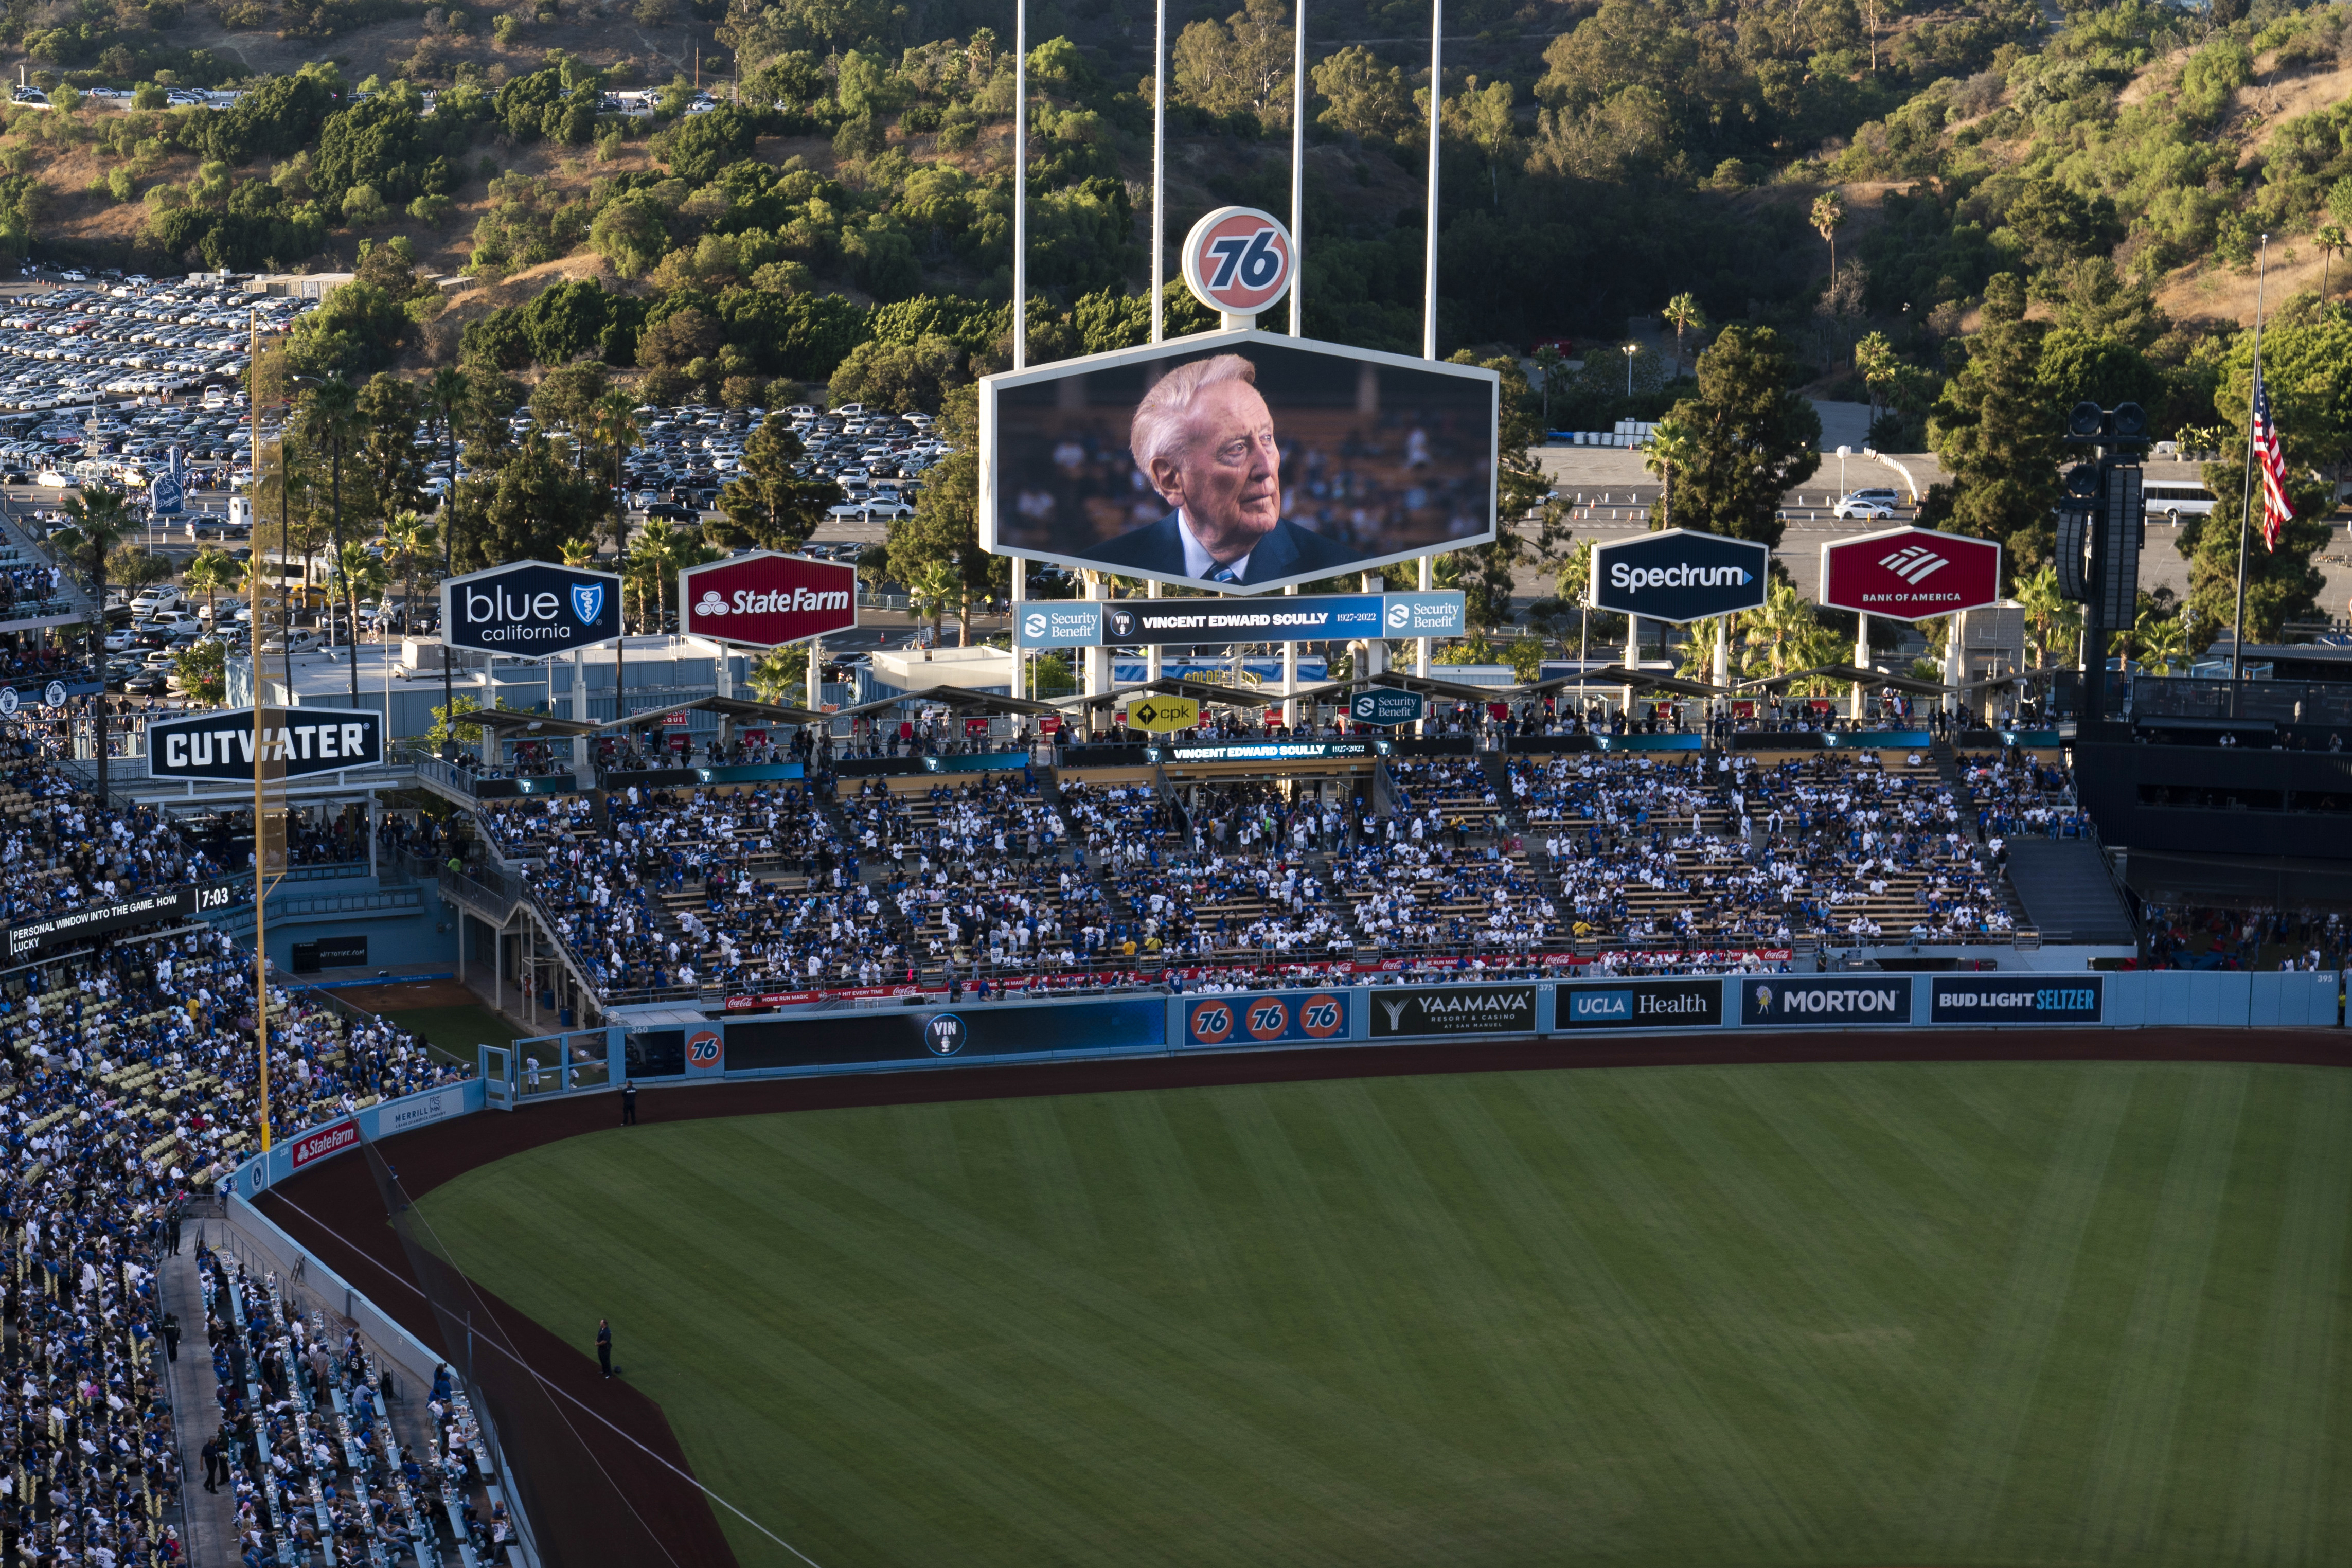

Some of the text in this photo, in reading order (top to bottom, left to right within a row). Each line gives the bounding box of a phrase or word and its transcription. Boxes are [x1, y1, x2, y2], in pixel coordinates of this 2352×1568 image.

[1206, 227, 1284, 291] 76
[158, 494, 180, 507] Dodgers
[1611, 563, 1743, 593] Spectrum
[466, 585, 559, 623] blue
[1862, 593, 1961, 602] BANK OF AMERICA
[1115, 611, 1130, 625] VIN
[1413, 603, 1459, 618] Security
[1051, 612, 1098, 627] Security
[1142, 612, 1376, 629] VINCENT EDWARD SCULLY 1927-2022
[1414, 615, 1455, 628] Benefit
[481, 623, 571, 642] california
[1051, 625, 1092, 638] Benefit
[1378, 697, 1417, 710] Security
[1160, 705, 1190, 722] cpk
[1378, 707, 1412, 717] Benefit
[166, 723, 365, 768] CUTWATER
[1173, 744, 1365, 760] VINCENT EDWARD SCULLY 1927-2022
[202, 887, 228, 907] 7:03
[13, 895, 177, 940] PERSONAL WINDOW INTO THE GAME. HOW
[13, 937, 40, 953] LUCKY
[320, 949, 365, 958] NITTOTIRE.COM
[1545, 954, 1571, 965] Coca-Cola
[1764, 951, 1790, 959] Coca-Cola
[2317, 974, 2333, 983] 395
[1539, 984, 1554, 992] 375
[728, 997, 754, 1008] Coca-Cola
[1578, 993, 1707, 1014] UCLA Health
[1784, 990, 1896, 1012] MORTON
[1939, 989, 2095, 1011] BUD LIGHT SELTZER
[1197, 1008, 1228, 1034] 76
[1251, 1005, 1284, 1031] 76
[1306, 1002, 1338, 1028] 76
[933, 1021, 957, 1036] VIN
[691, 1038, 719, 1060] 76
[395, 1107, 428, 1123] MERRILL
[280, 1147, 289, 1157] 330
[351, 1361, 359, 1369] 50
[97, 1555, 105, 1564] 35
